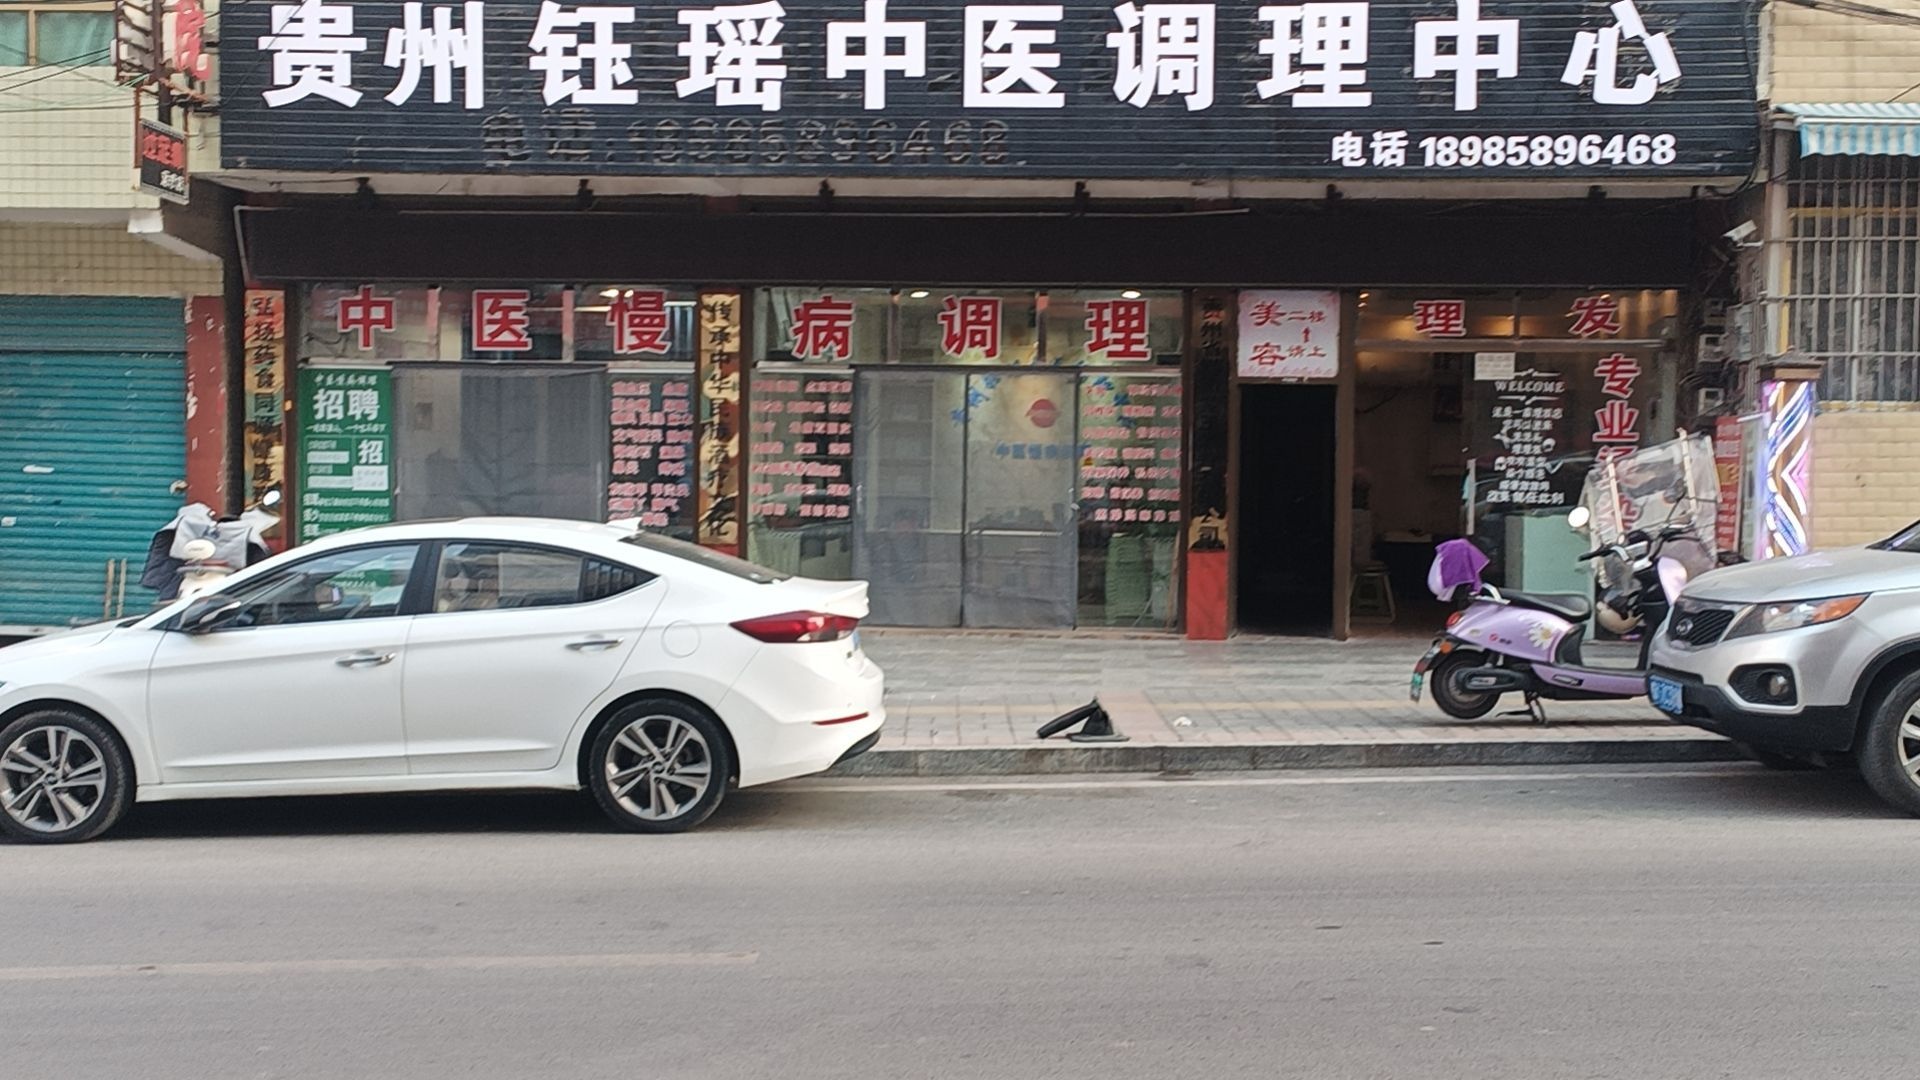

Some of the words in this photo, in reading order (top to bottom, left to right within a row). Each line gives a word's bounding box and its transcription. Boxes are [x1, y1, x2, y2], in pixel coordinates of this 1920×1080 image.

[258, 0, 1682, 112] 贵州钰瑶中医调理中心
[1331, 130, 1409, 169] 电话
[1418, 133, 1677, 168] 18985896468
[1494, 381, 1565, 393] WELCOME
[312, 388, 381, 421] 招聘
[358, 439, 384, 465] 招
